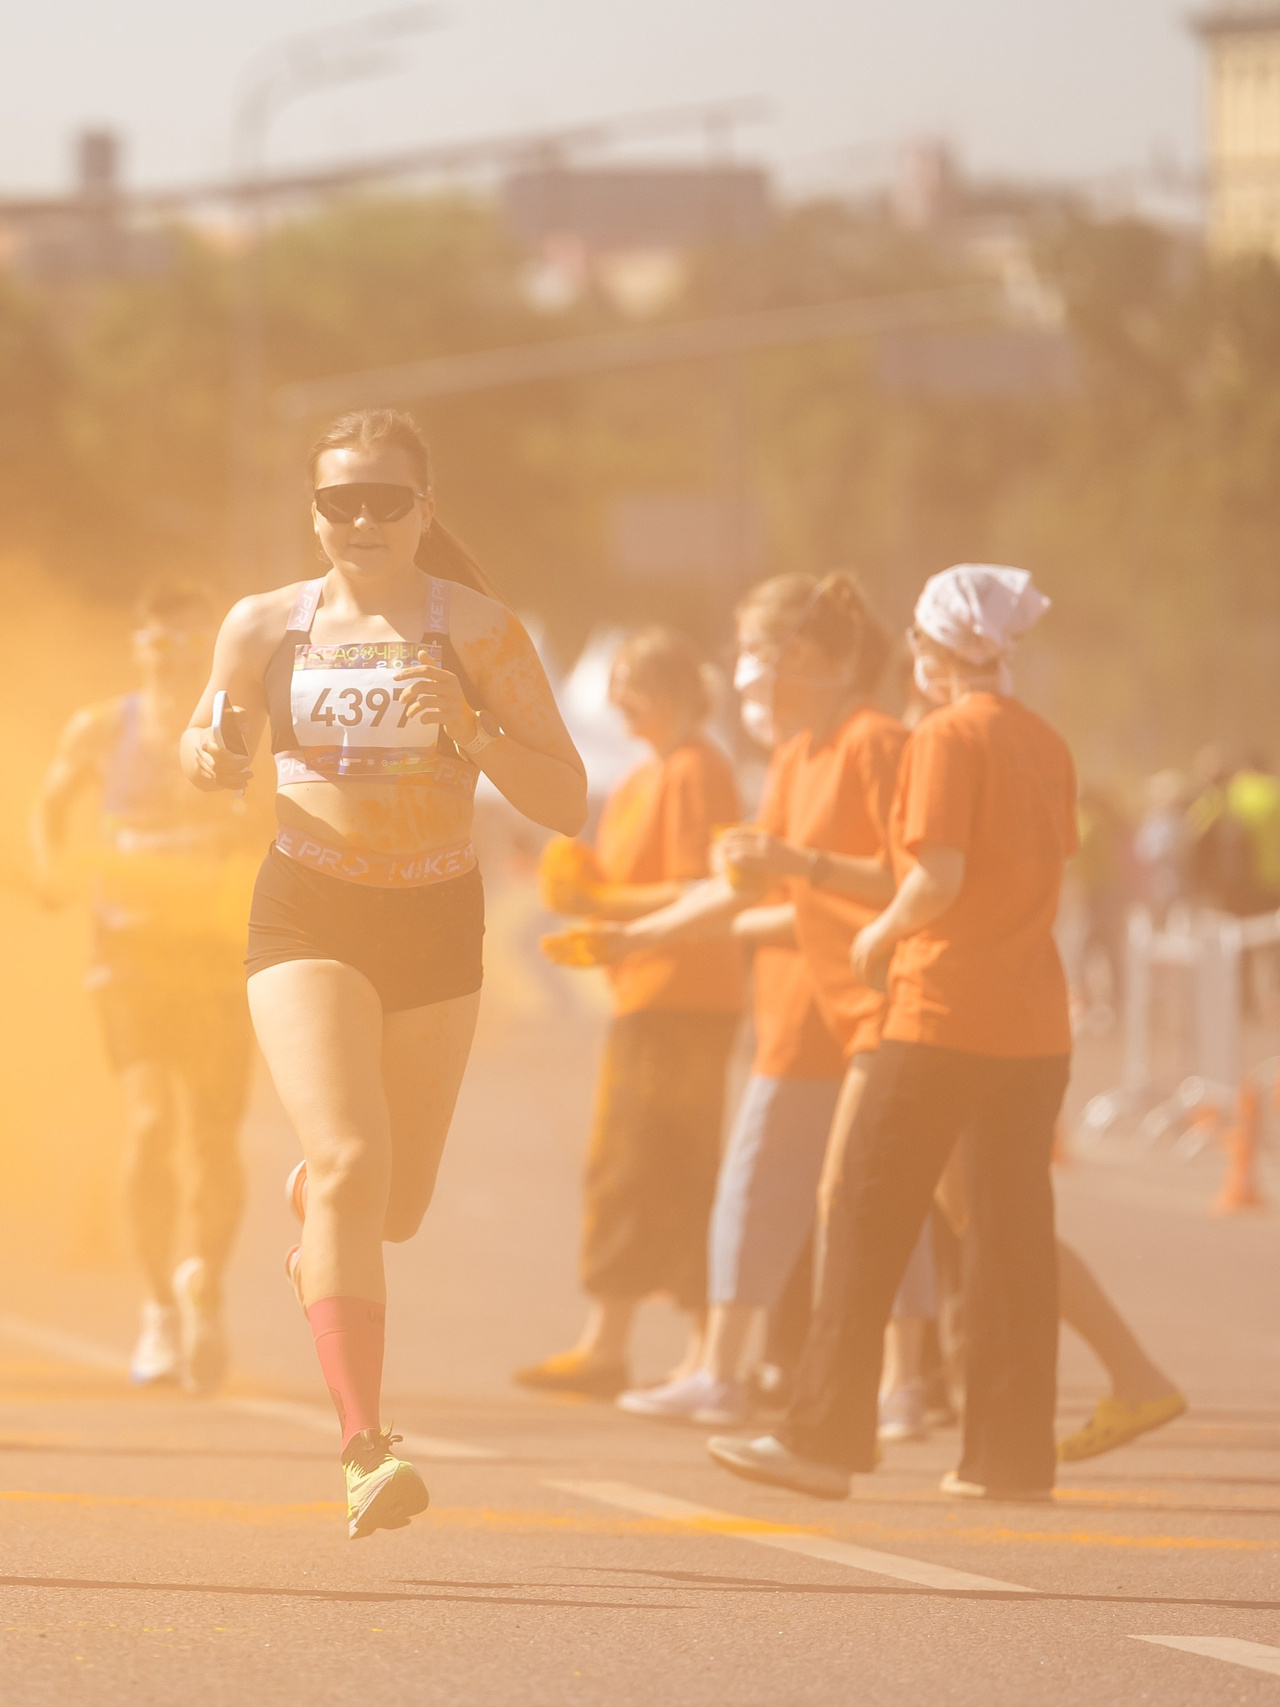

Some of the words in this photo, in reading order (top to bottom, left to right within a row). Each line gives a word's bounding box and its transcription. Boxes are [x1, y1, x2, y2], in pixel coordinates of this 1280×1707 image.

[310, 687, 411, 728] 4397
[297, 840, 369, 876] PRO
[387, 849, 461, 882] NIKE
